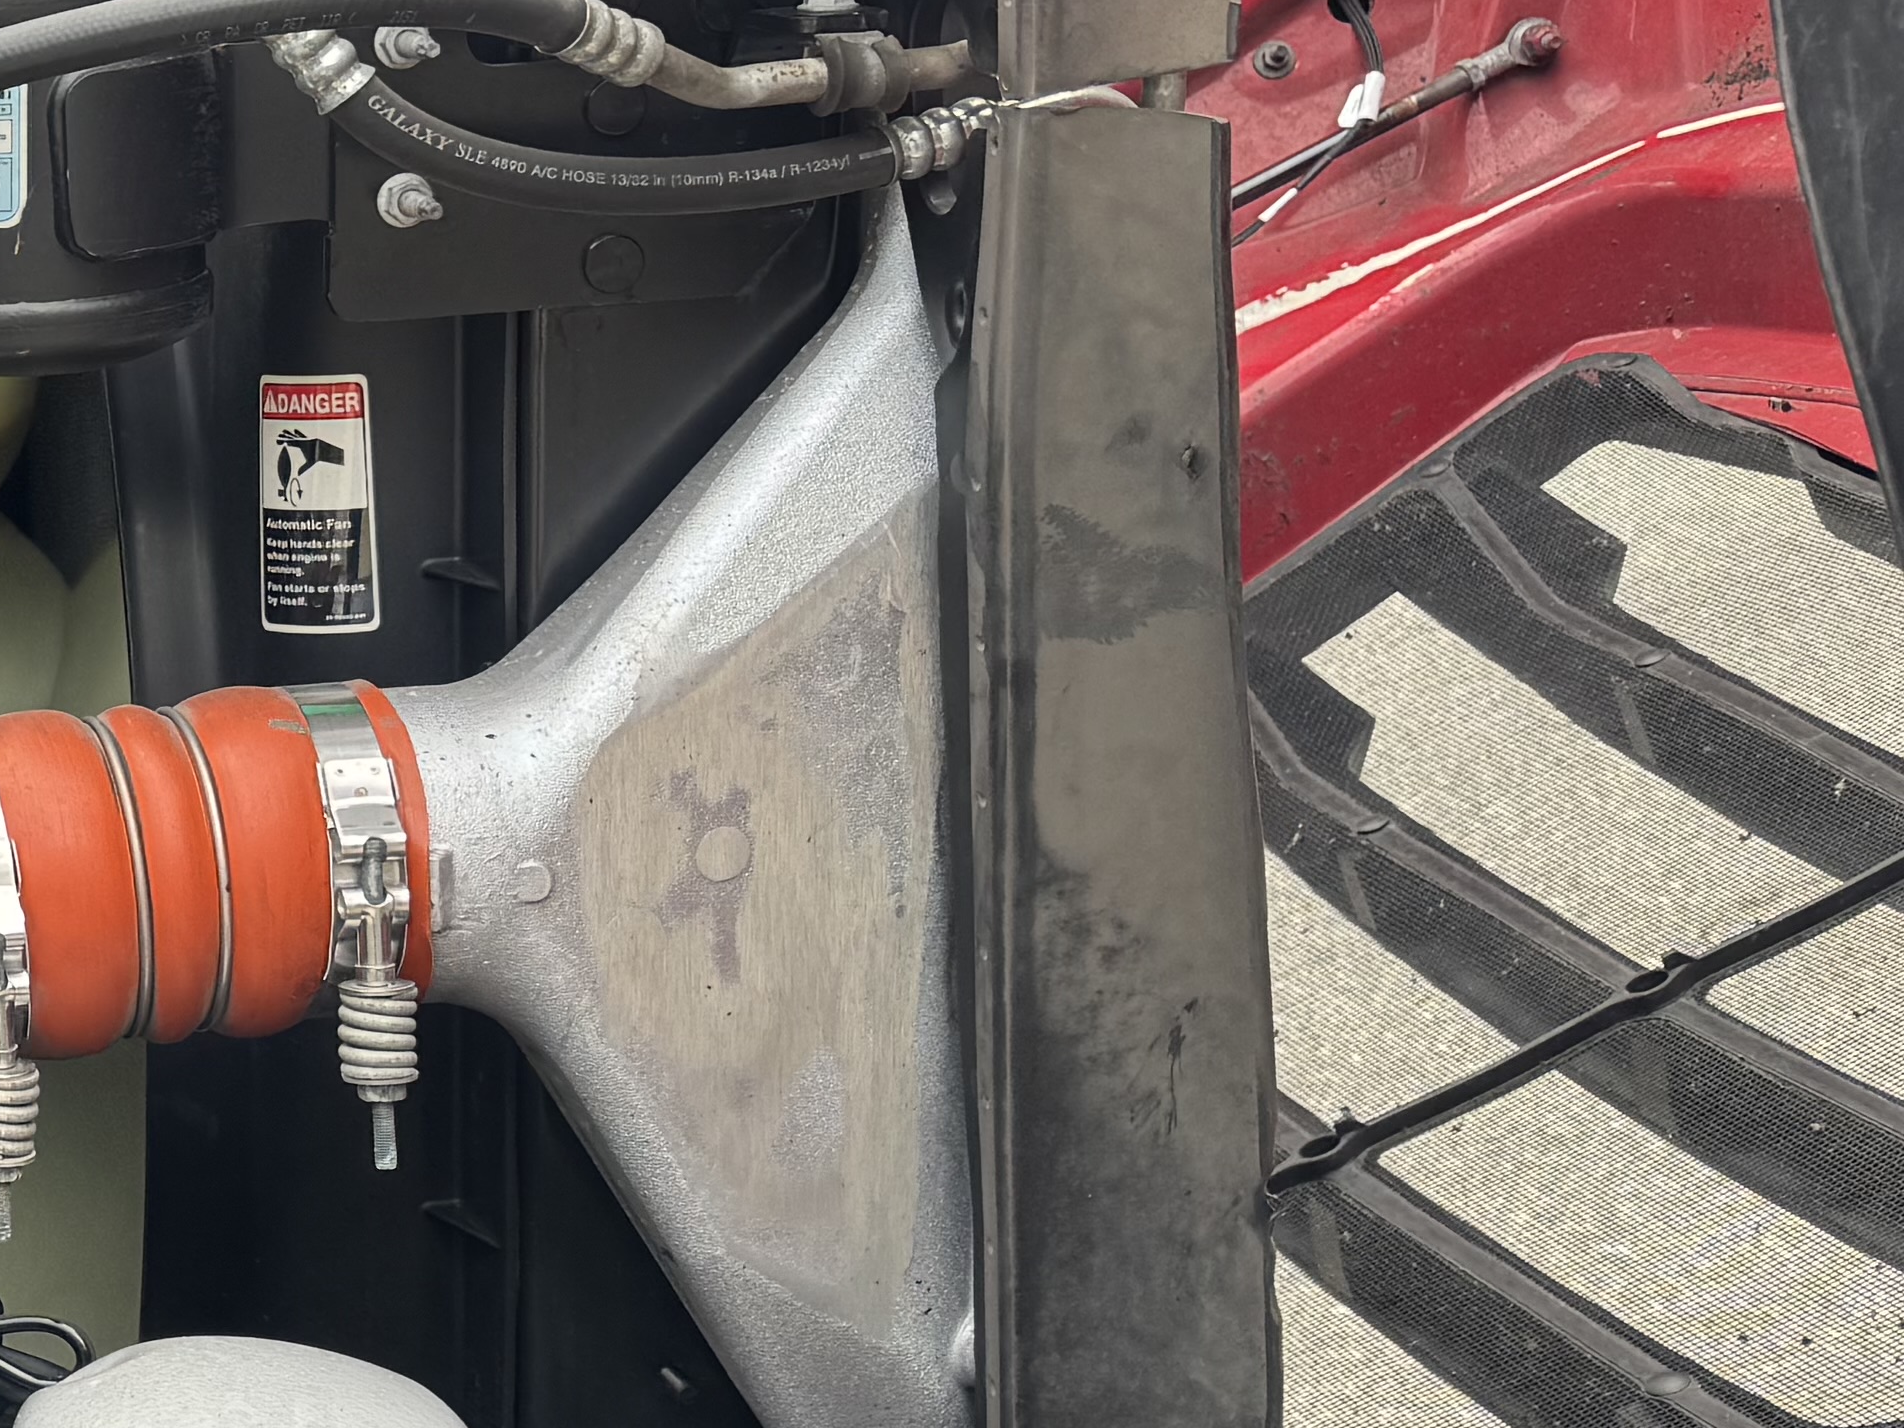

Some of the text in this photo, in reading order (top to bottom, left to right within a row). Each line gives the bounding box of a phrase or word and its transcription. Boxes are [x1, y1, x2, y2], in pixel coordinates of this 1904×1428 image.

[367, 94, 456, 152] GALAXY
[454, 142, 488, 165] SLE
[490, 156, 527, 174] 4890
[530, 164, 559, 180] A/C
[561, 168, 608, 185] HOSE
[610, 172, 650, 189] 13/32
[652, 173, 667, 187] in
[670, 172, 724, 189] (10mm)
[728, 167, 779, 185] R-134a
[277, 391, 361, 415] DANGER
[266, 517, 353, 531] Automatic Fan
[289, 538, 323, 549] hands
[325, 538, 356, 549] clear
[266, 551, 290, 562] when
[291, 552, 328, 564] engine
[267, 581, 283, 592] Fan
[317, 584, 330, 593] or
